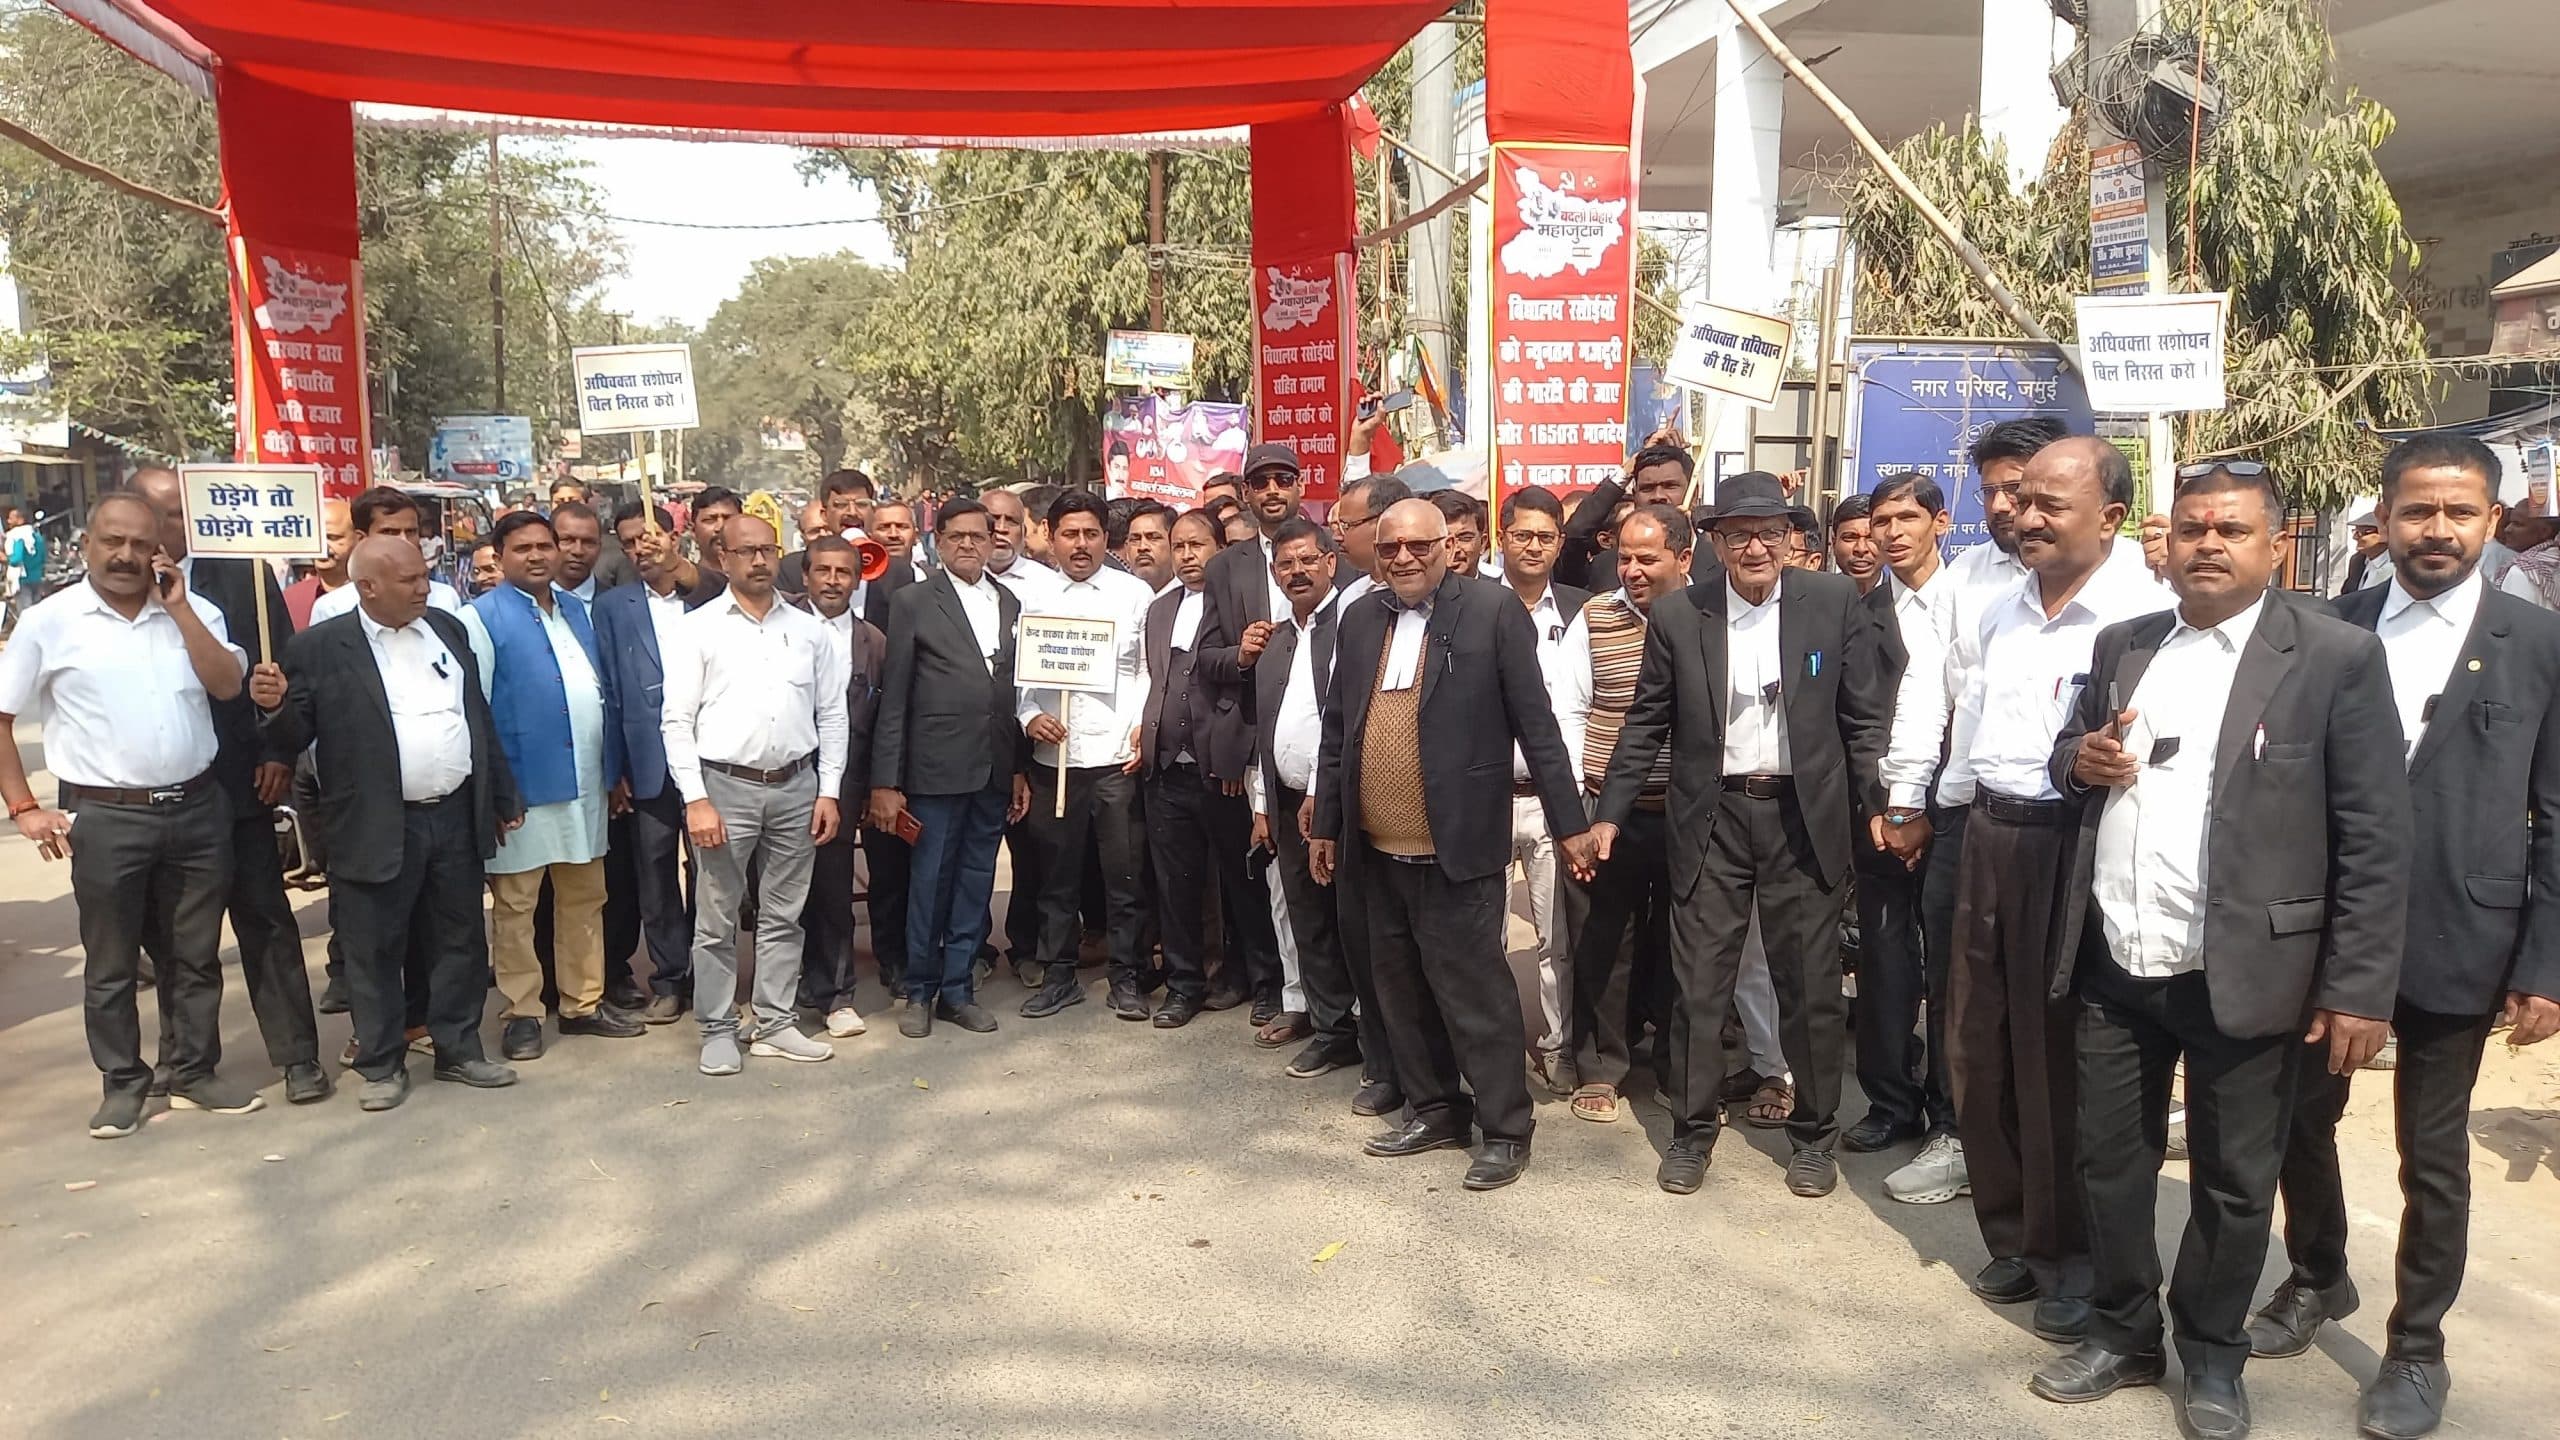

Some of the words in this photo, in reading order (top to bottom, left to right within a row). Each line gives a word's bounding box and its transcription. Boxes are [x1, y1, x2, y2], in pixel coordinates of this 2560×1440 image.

[1538, 224, 1604, 244] महाजुटान
[1508, 292, 1564, 321] विद्यालय
[1690, 324, 1739, 349] अधिवक्ता
[2089, 331, 2151, 352] अधिवक्ता
[266, 340, 312, 361] सरकार
[1262, 344, 1298, 366] विद्यालय
[1500, 334, 1521, 363] को
[1703, 350, 1720, 368] की
[1722, 354, 1740, 377] रीढ़
[2092, 360, 2118, 382] बिल
[2125, 360, 2163, 382] निरस्त
[584, 373, 637, 390] अधिवक्ता
[1273, 374, 1298, 395] सहित
[1300, 376, 1326, 393] तमाम
[1502, 376, 1523, 404] की
[1568, 376, 1590, 404] की
[1592, 382, 1622, 404] जाए
[1912, 378, 1948, 398] नगर
[1954, 374, 2013, 402] परिषद,
[2017, 374, 2058, 404] जमुई
[276, 399, 304, 422] प्रति
[308, 405, 342, 424] हजार
[616, 394, 648, 410] निरस्त
[654, 392, 674, 407] करो
[1268, 405, 1292, 426] स्कीम
[1294, 403, 1316, 424] वर्कर
[1318, 402, 1332, 423] को
[298, 432, 336, 454] बनाने
[339, 436, 358, 455] पर
[1300, 433, 1336, 454] कर्मचारी
[338, 464, 359, 484] की
[1314, 464, 1325, 484] दो
[1504, 458, 1524, 486] को
[1918, 464, 1938, 478] का
[1942, 464, 1970, 478] नाम
[268, 484, 294, 506] तो
[1962, 524, 1976, 534] पर
[1042, 630, 1064, 639] सरकार
[1038, 644, 1068, 654] अधिवक्ता
[1041, 658, 1054, 670] बिल
